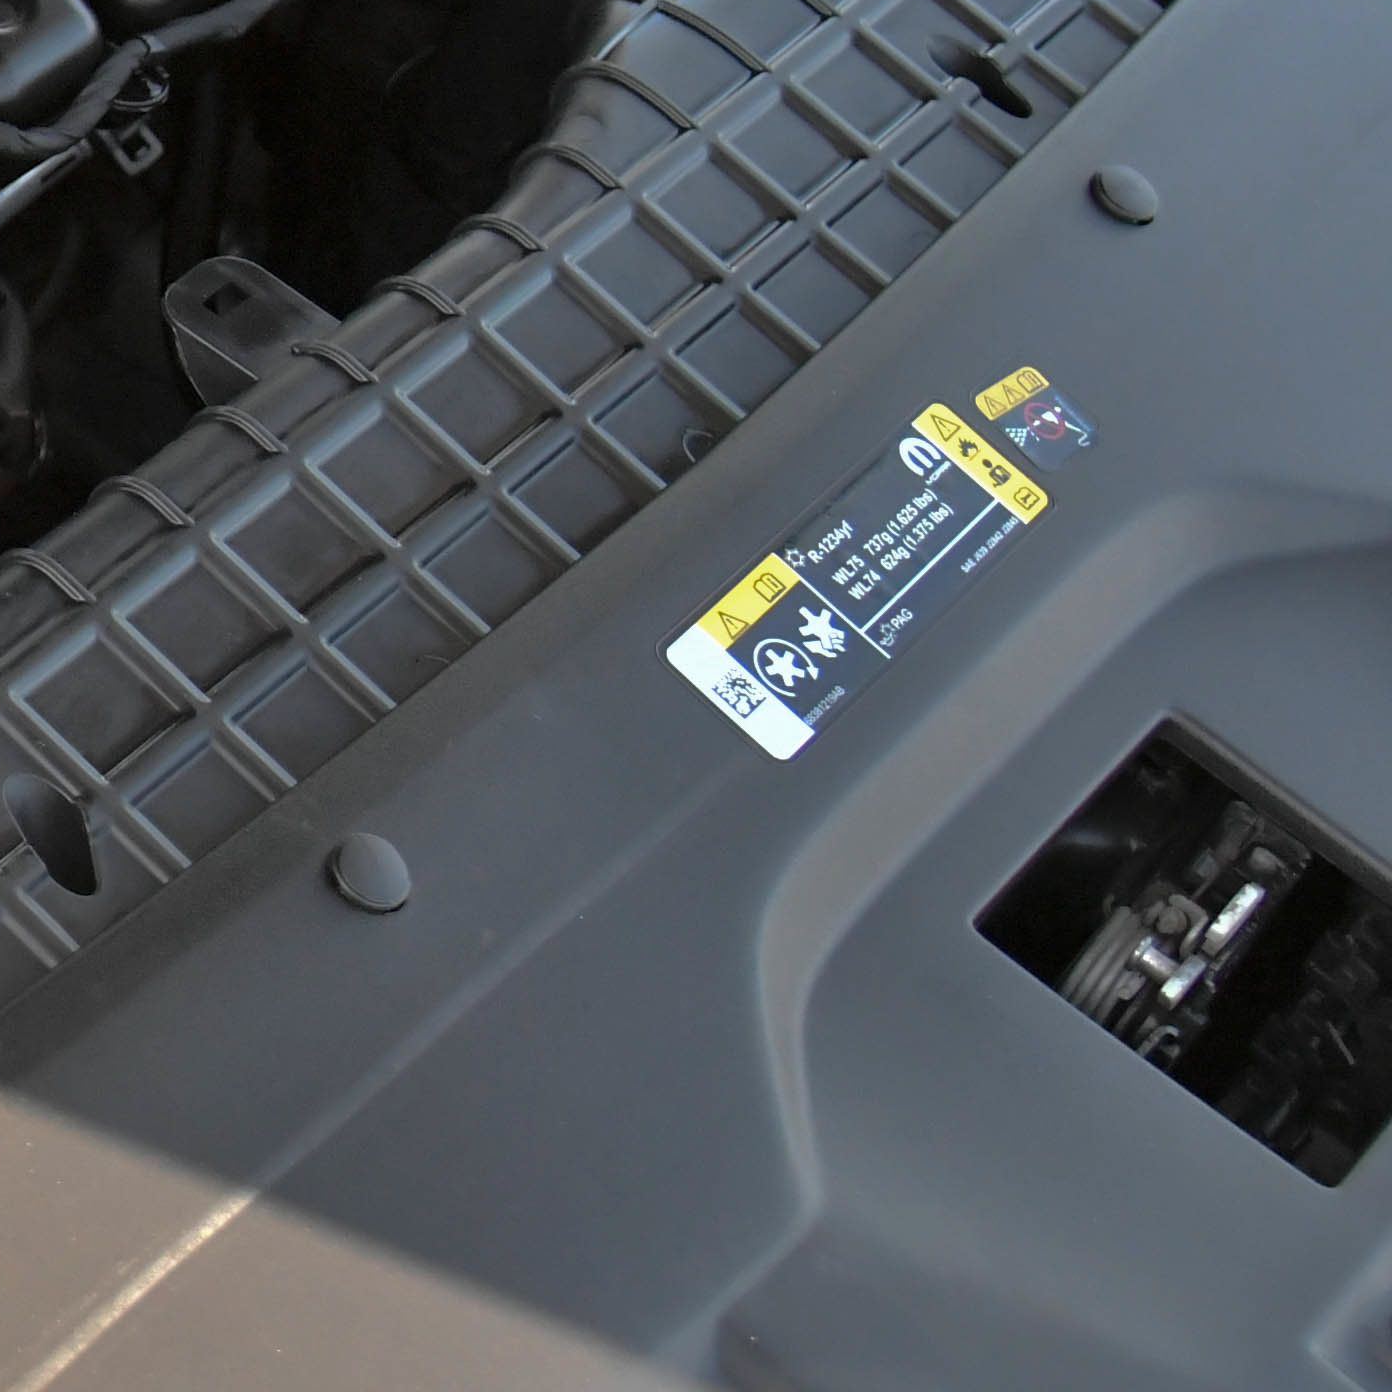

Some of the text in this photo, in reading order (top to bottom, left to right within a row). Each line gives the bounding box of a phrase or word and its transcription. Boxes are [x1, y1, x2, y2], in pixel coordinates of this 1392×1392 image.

[807, 519, 854, 563] R-1234yf
[831, 488, 938, 585] WL75 737g (1.625 lbs)
[848, 502, 954, 600] WL74 624g (1.375 lbs)
[890, 608, 913, 629] PAG
